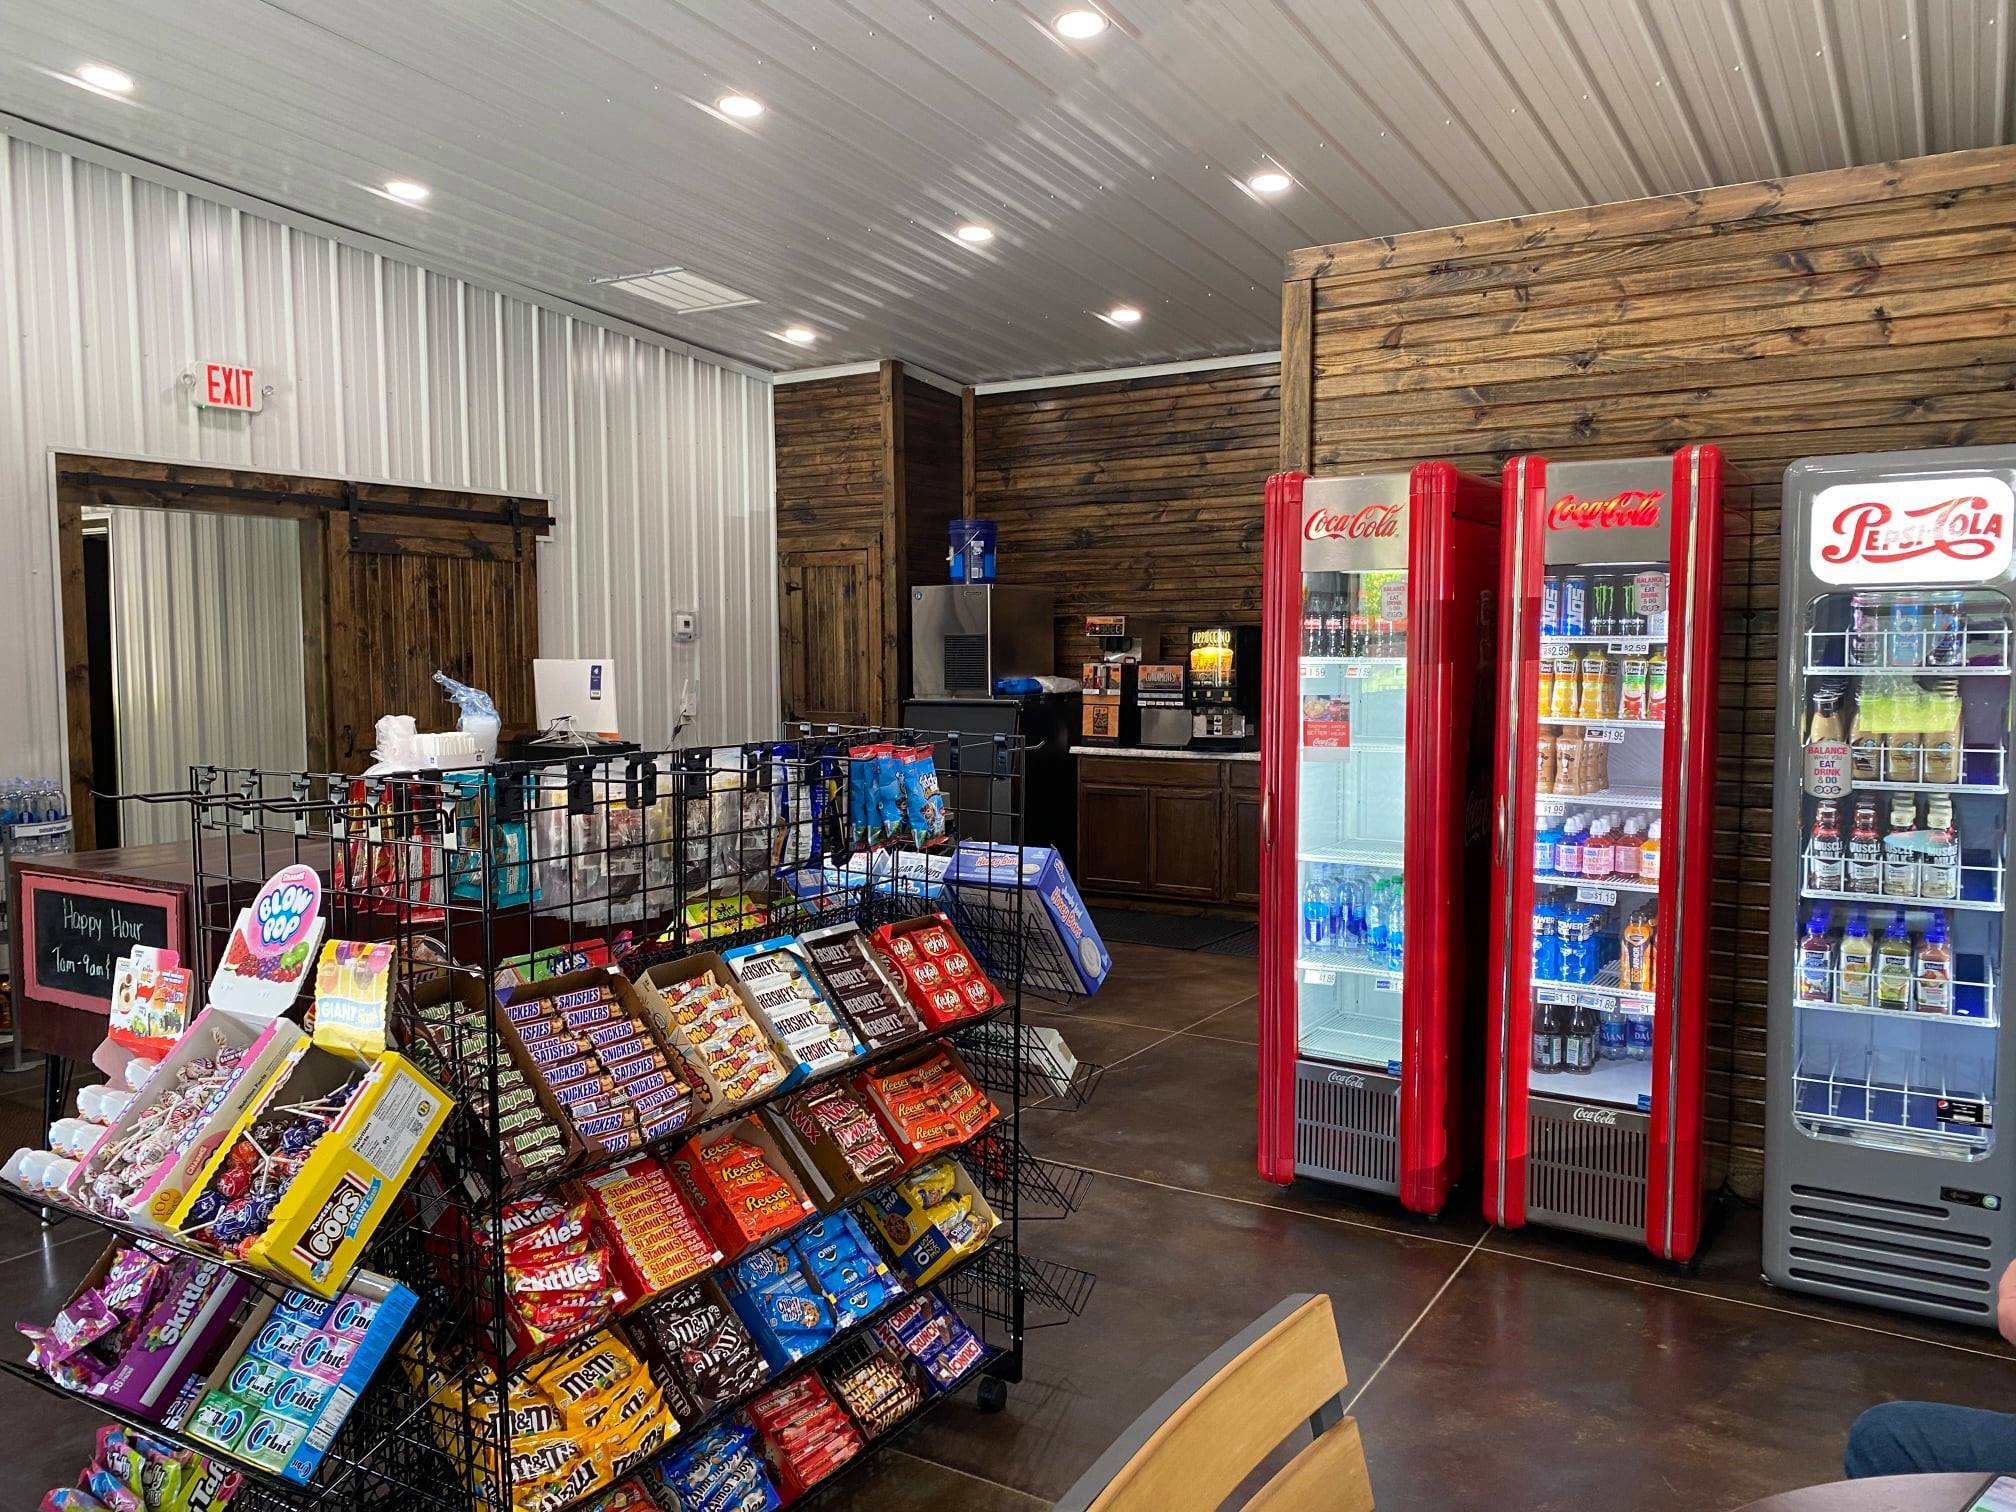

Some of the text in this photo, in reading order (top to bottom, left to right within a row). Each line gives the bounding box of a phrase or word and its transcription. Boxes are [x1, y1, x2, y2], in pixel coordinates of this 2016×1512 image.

[207, 365, 253, 408] EXIT
[1548, 489, 1666, 531] Coca-Cola
[1304, 503, 1406, 541] Coca-Cola
[1624, 644, 1647, 652] $2.59
[1807, 746, 1848, 756] BALANCE
[1813, 767, 1841, 776] DRINK
[1819, 760, 1835, 768] EAT
[1824, 776, 1838, 784] DO
[259, 885, 314, 921] BLOW
[1594, 891, 1616, 903] $1.19
[63, 897, 144, 941] Happy Hour
[263, 915, 300, 945] POP
[559, 988, 599, 1010] SATISFIES
[756, 986, 799, 1010] HERSHEY'S
[1554, 993, 1577, 1004] $1.19
[1594, 998, 1615, 1010] $1.89
[321, 1001, 357, 1020] GIANT
[568, 1006, 608, 1026] SNICKERS
[592, 1023, 632, 1045] SNICKERS
[775, 1010, 818, 1036] HERSHEY'S
[533, 1041, 577, 1063] SATISFIES
[602, 1040, 641, 1063] SNICKERS
[796, 1038, 839, 1062] HERSHEY'S
[545, 1062, 585, 1084] SNICKERS
[614, 1056, 653, 1082] SATISFIES
[1327, 1070, 1366, 1089] Coca-Cola
[557, 1081, 599, 1103] SNICKERS
[627, 1073, 664, 1097] SNICKERS
[637, 1086, 677, 1111] SATISFIES
[579, 1114, 622, 1136] SNICKERS
[1573, 1107, 1617, 1126] Coca-Cola
[352, 1121, 372, 1150] Nutrition
[608, 1176, 649, 1199] Starburst
[613, 1189, 655, 1211] Starburst
[746, 1187, 791, 1212] Reese's
[310, 1190, 362, 1255] POPS
[656, 1261, 698, 1286] Starburst
[159, 1261, 219, 1345] Skittles
[908, 1321, 939, 1355] CRUNCH
[300, 1335, 346, 1369] Orbit
[950, 1342, 979, 1375] CRUNCH
[109, 1380, 124, 1394] 36
[273, 1376, 320, 1412] Orbit
[246, 1418, 292, 1455] Orbit
